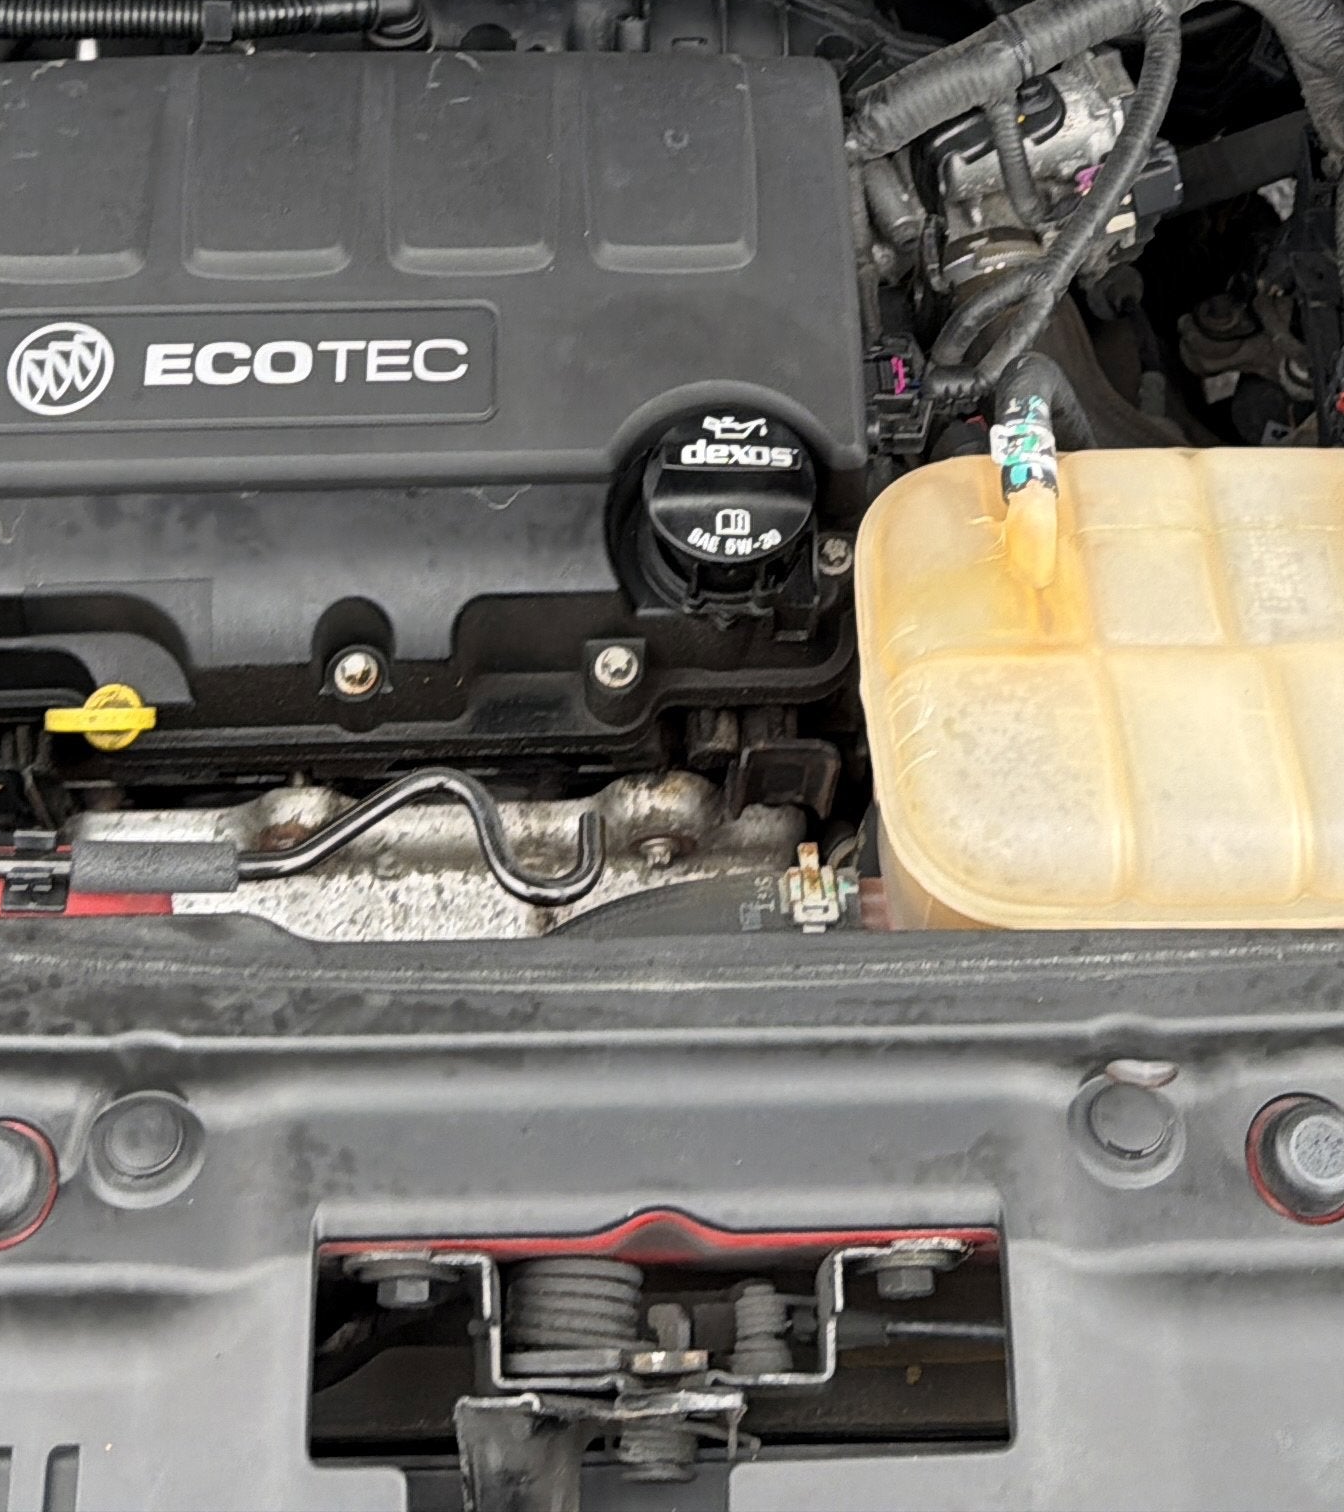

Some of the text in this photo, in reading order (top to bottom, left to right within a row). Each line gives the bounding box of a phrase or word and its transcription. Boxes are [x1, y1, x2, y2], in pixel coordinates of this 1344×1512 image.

[143, 338, 469, 386] ECOTEC
[680, 439, 794, 467] dexos
[687, 527, 721, 554] SAE
